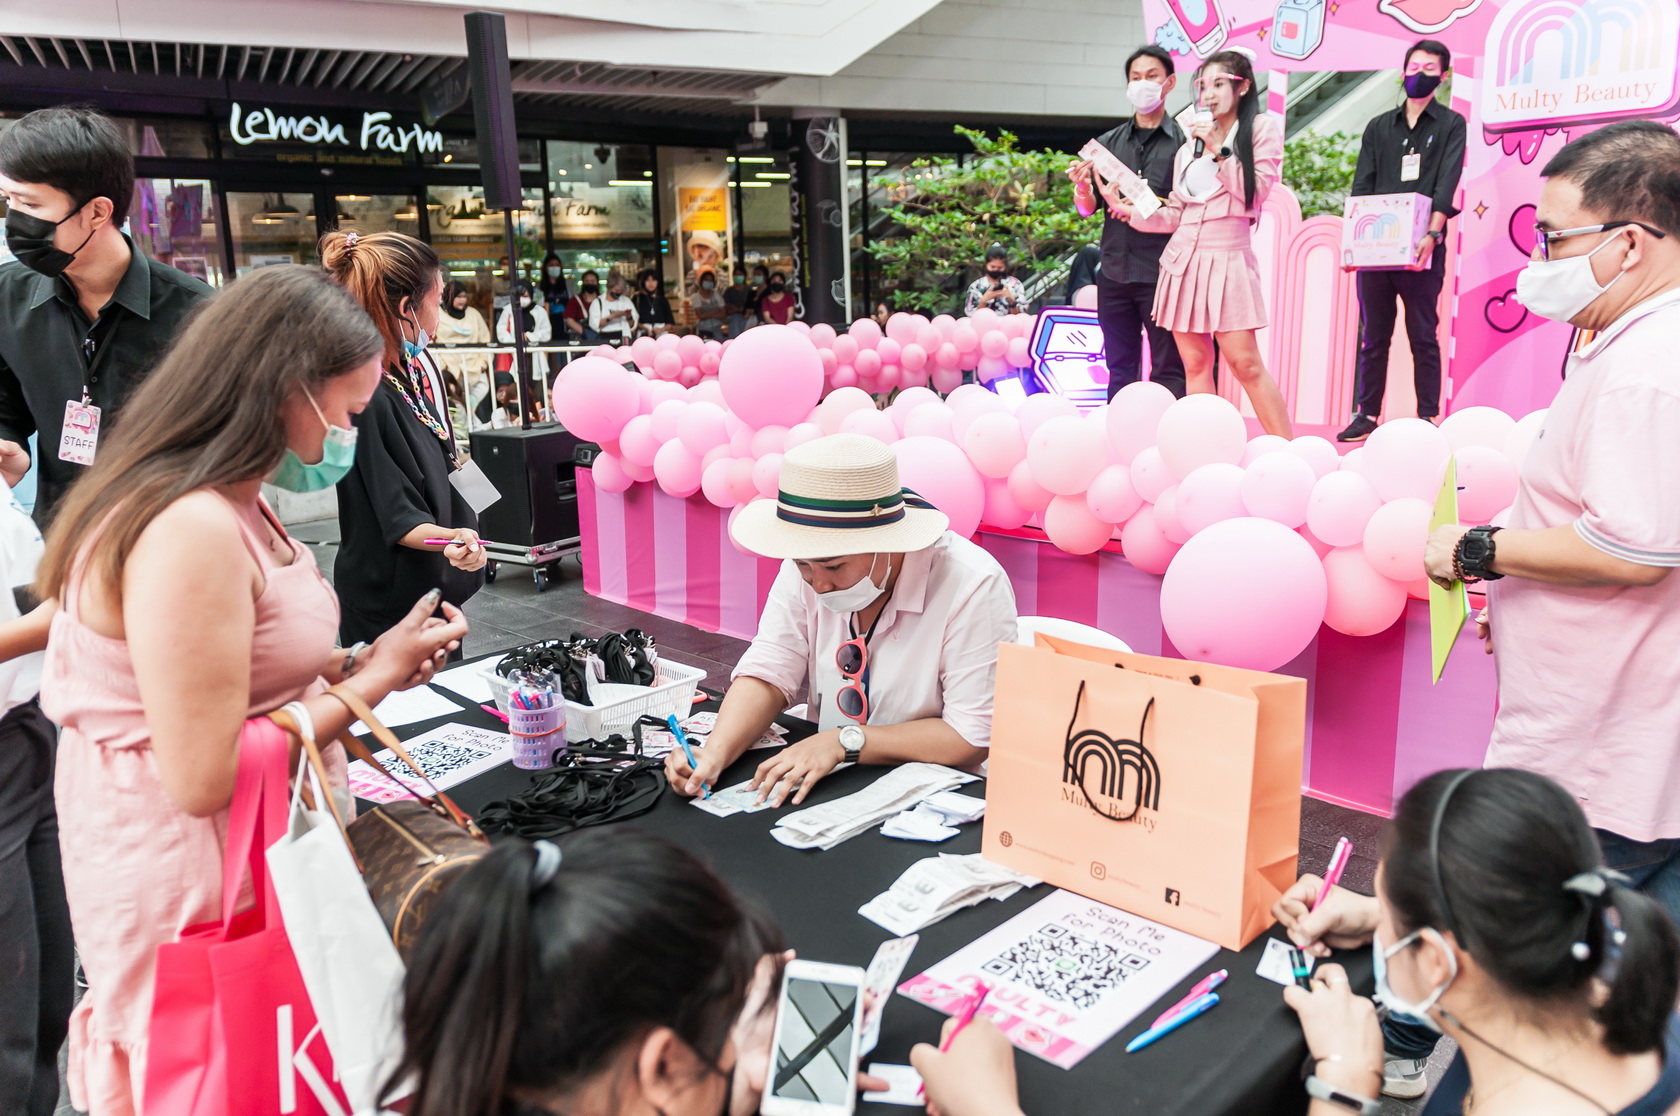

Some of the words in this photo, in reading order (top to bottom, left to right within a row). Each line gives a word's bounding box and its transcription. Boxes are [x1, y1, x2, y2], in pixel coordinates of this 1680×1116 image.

[1494, 89, 1563, 113] Multy
[1574, 82, 1657, 104] Beauty
[230, 102, 349, 145] Lemon
[360, 111, 443, 153] Farm
[64, 436, 94, 449] STAFF
[443, 734, 463, 742] for
[467, 738, 502, 751] Photo
[463, 729, 489, 740] Scan
[1061, 787, 1102, 815] Muly
[1061, 913, 1095, 933] for
[1099, 924, 1162, 956] Photo
[1086, 907, 1131, 929] Scan
[1137, 924, 1165, 942] Me
